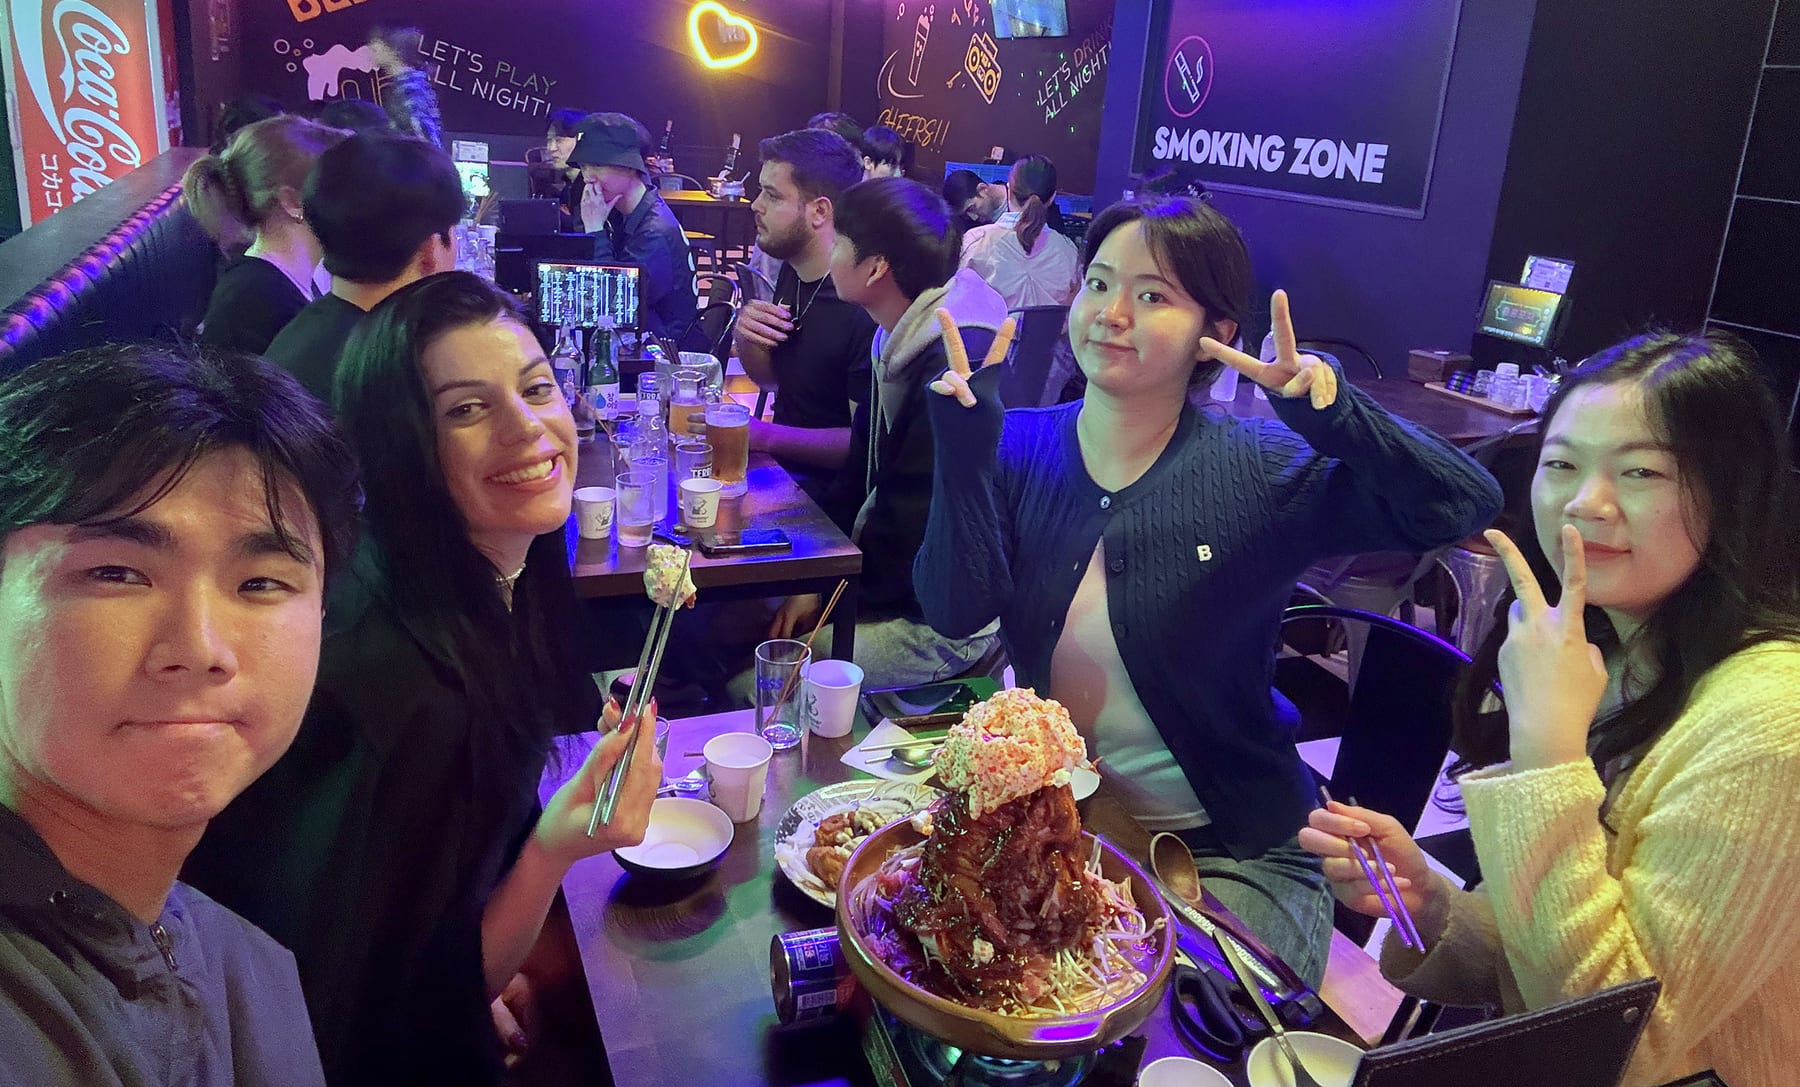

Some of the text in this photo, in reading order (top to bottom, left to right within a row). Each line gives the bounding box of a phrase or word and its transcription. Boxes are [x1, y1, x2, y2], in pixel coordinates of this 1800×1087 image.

[417, 35, 557, 97] LET'S PLAY
[1037, 61, 1071, 106] LET'S
[472, 78, 551, 118] NIGHT!
[1045, 97, 1068, 125] ALL
[1152, 126, 1389, 184] SMOKING ZONE
[1196, 544, 1212, 562] B
